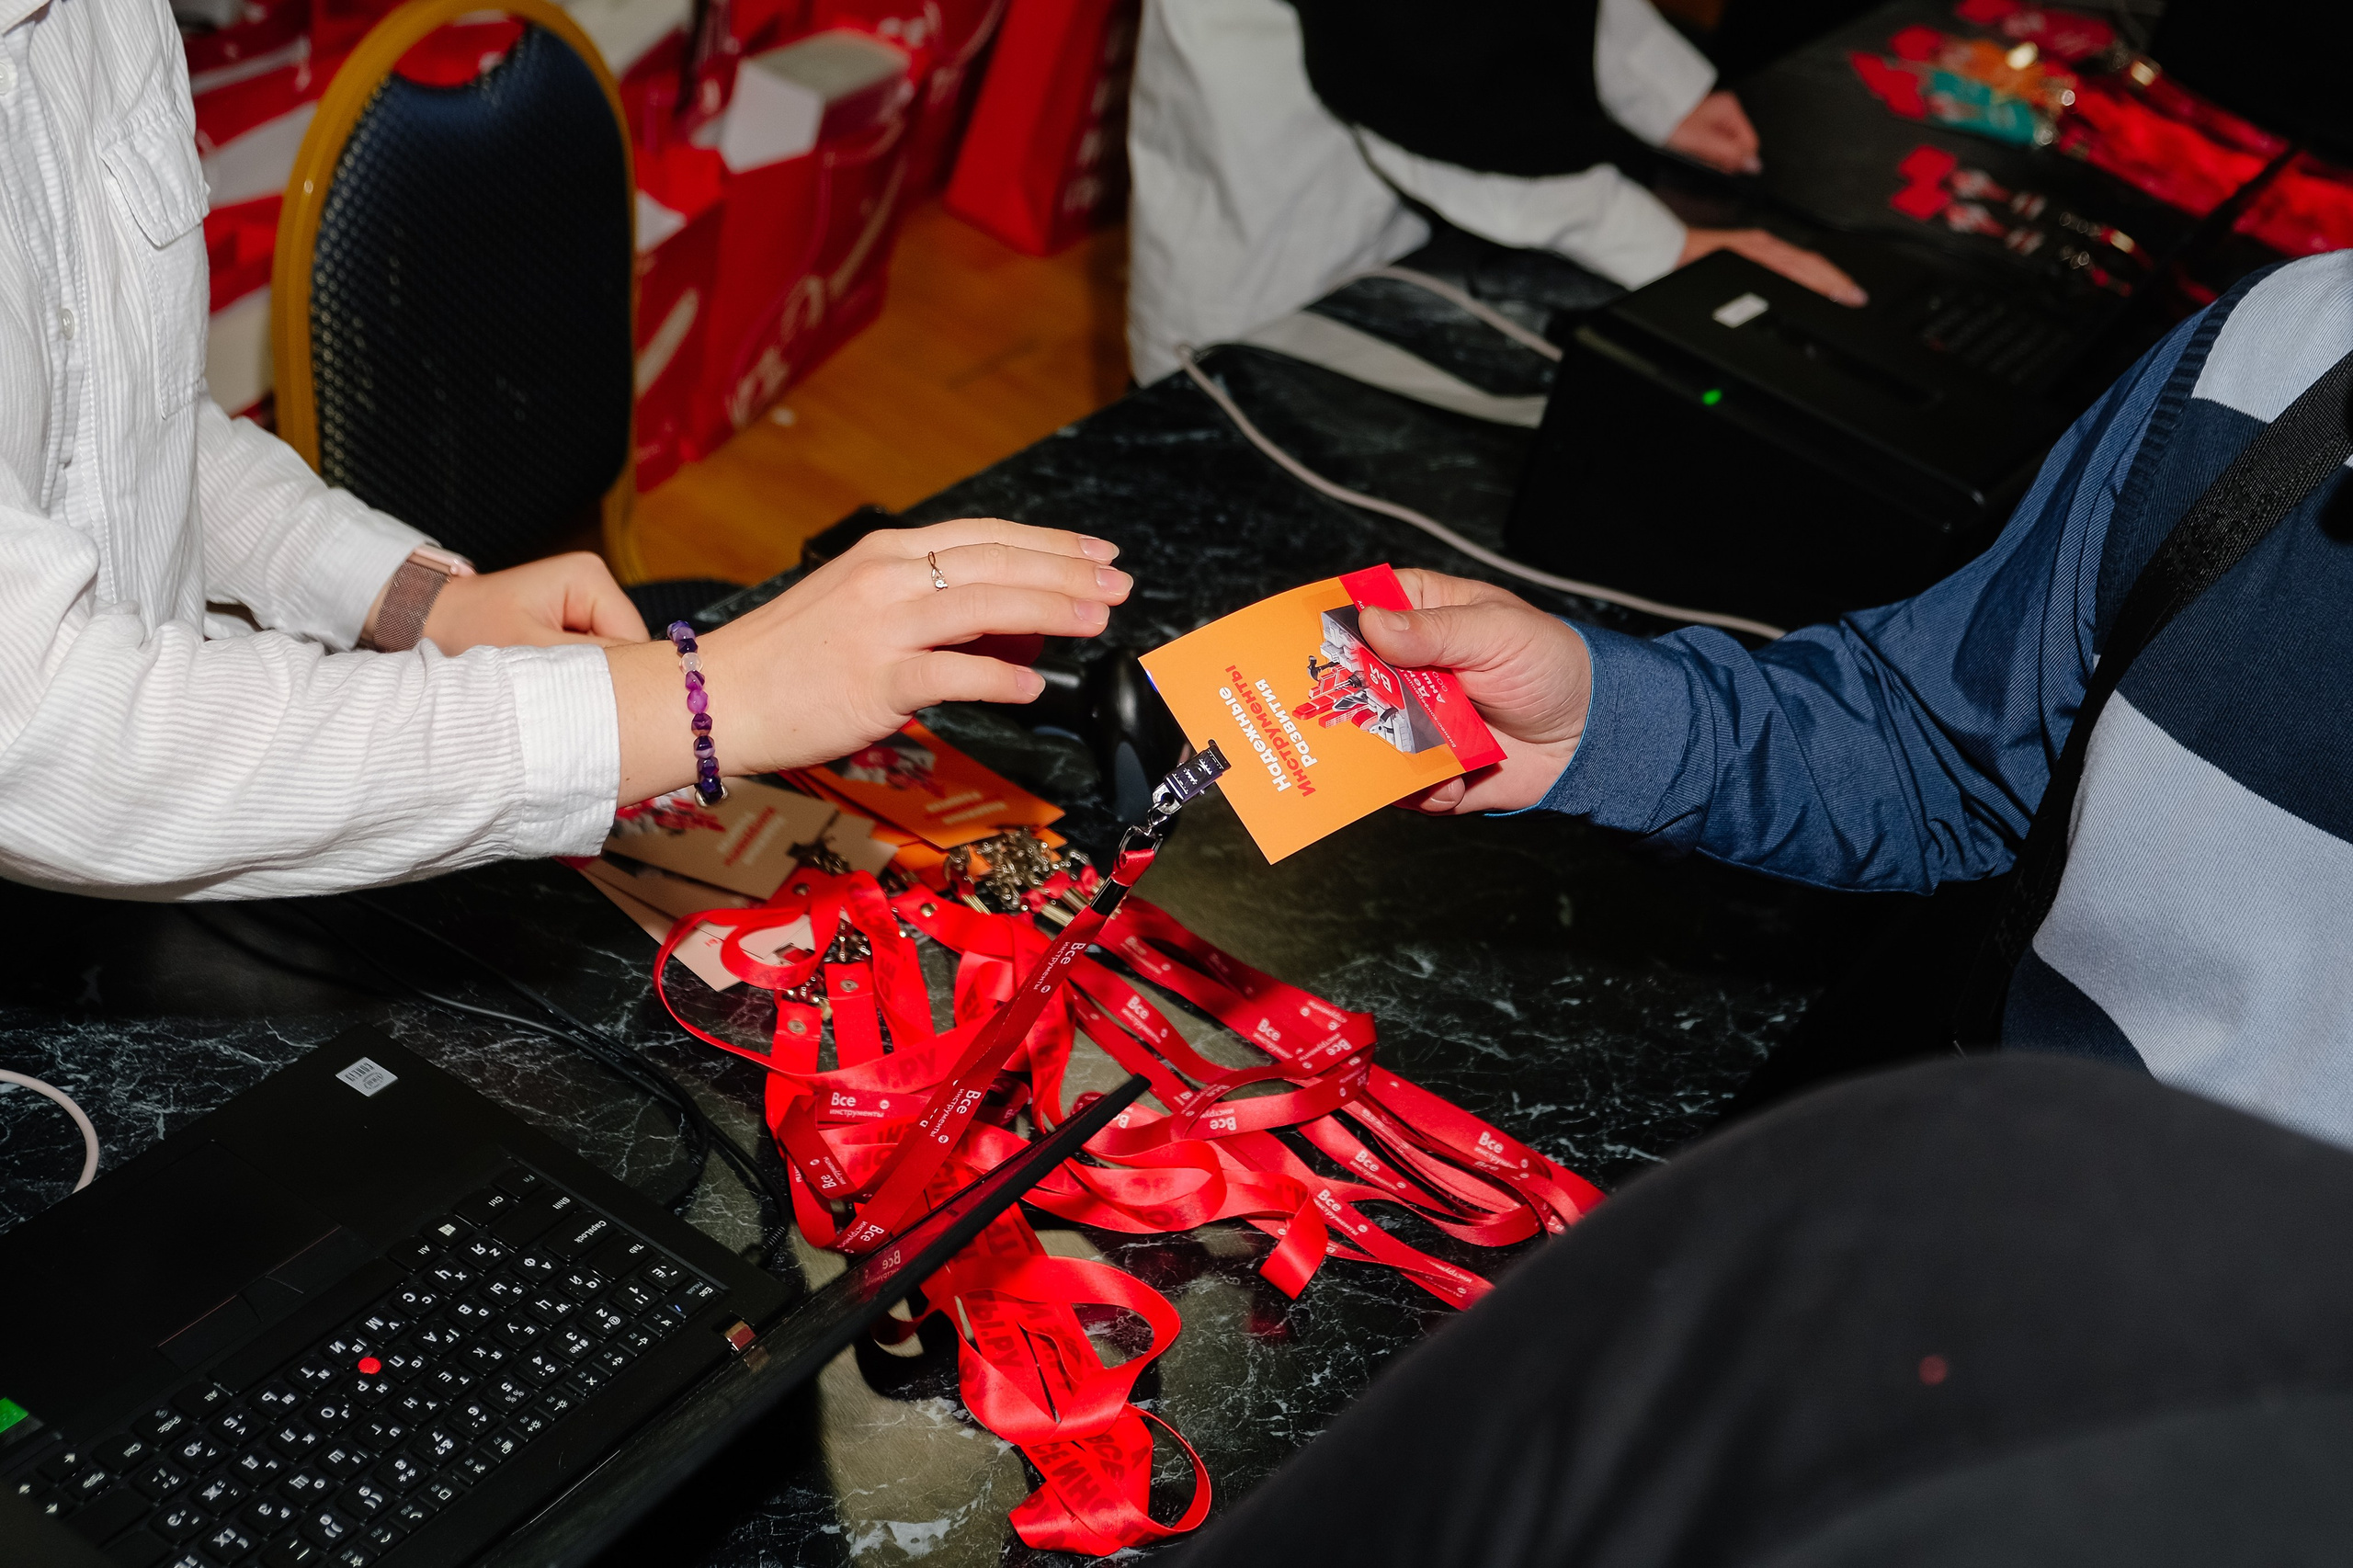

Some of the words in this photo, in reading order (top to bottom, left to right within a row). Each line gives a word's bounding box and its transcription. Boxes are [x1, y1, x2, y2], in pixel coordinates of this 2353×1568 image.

[1225, 665, 1316, 797] Инструменты
[1255, 678, 1318, 767] Развития
[1219, 687, 1291, 792] Надежные
[1060, 942, 1086, 965] Все
[1033, 941, 1070, 990] инструменты
[1127, 995, 1149, 1019] Все
[1256, 1017, 1281, 1041] Все
[1325, 1039, 1352, 1055] Все
[831, 1092, 857, 1107] Все
[957, 1090, 982, 1114] Все
[829, 1109, 884, 1118] инструменты
[930, 1088, 965, 1137] инструменты
[1210, 1117, 1237, 1131] Все
[1478, 1131, 1504, 1153] Все
[1355, 1150, 1379, 1172] Все
[821, 1174, 837, 1188] Все
[1349, 1160, 1398, 1191] инструменты
[1317, 1189, 1342, 1212] Все
[860, 1224, 884, 1241] Все
